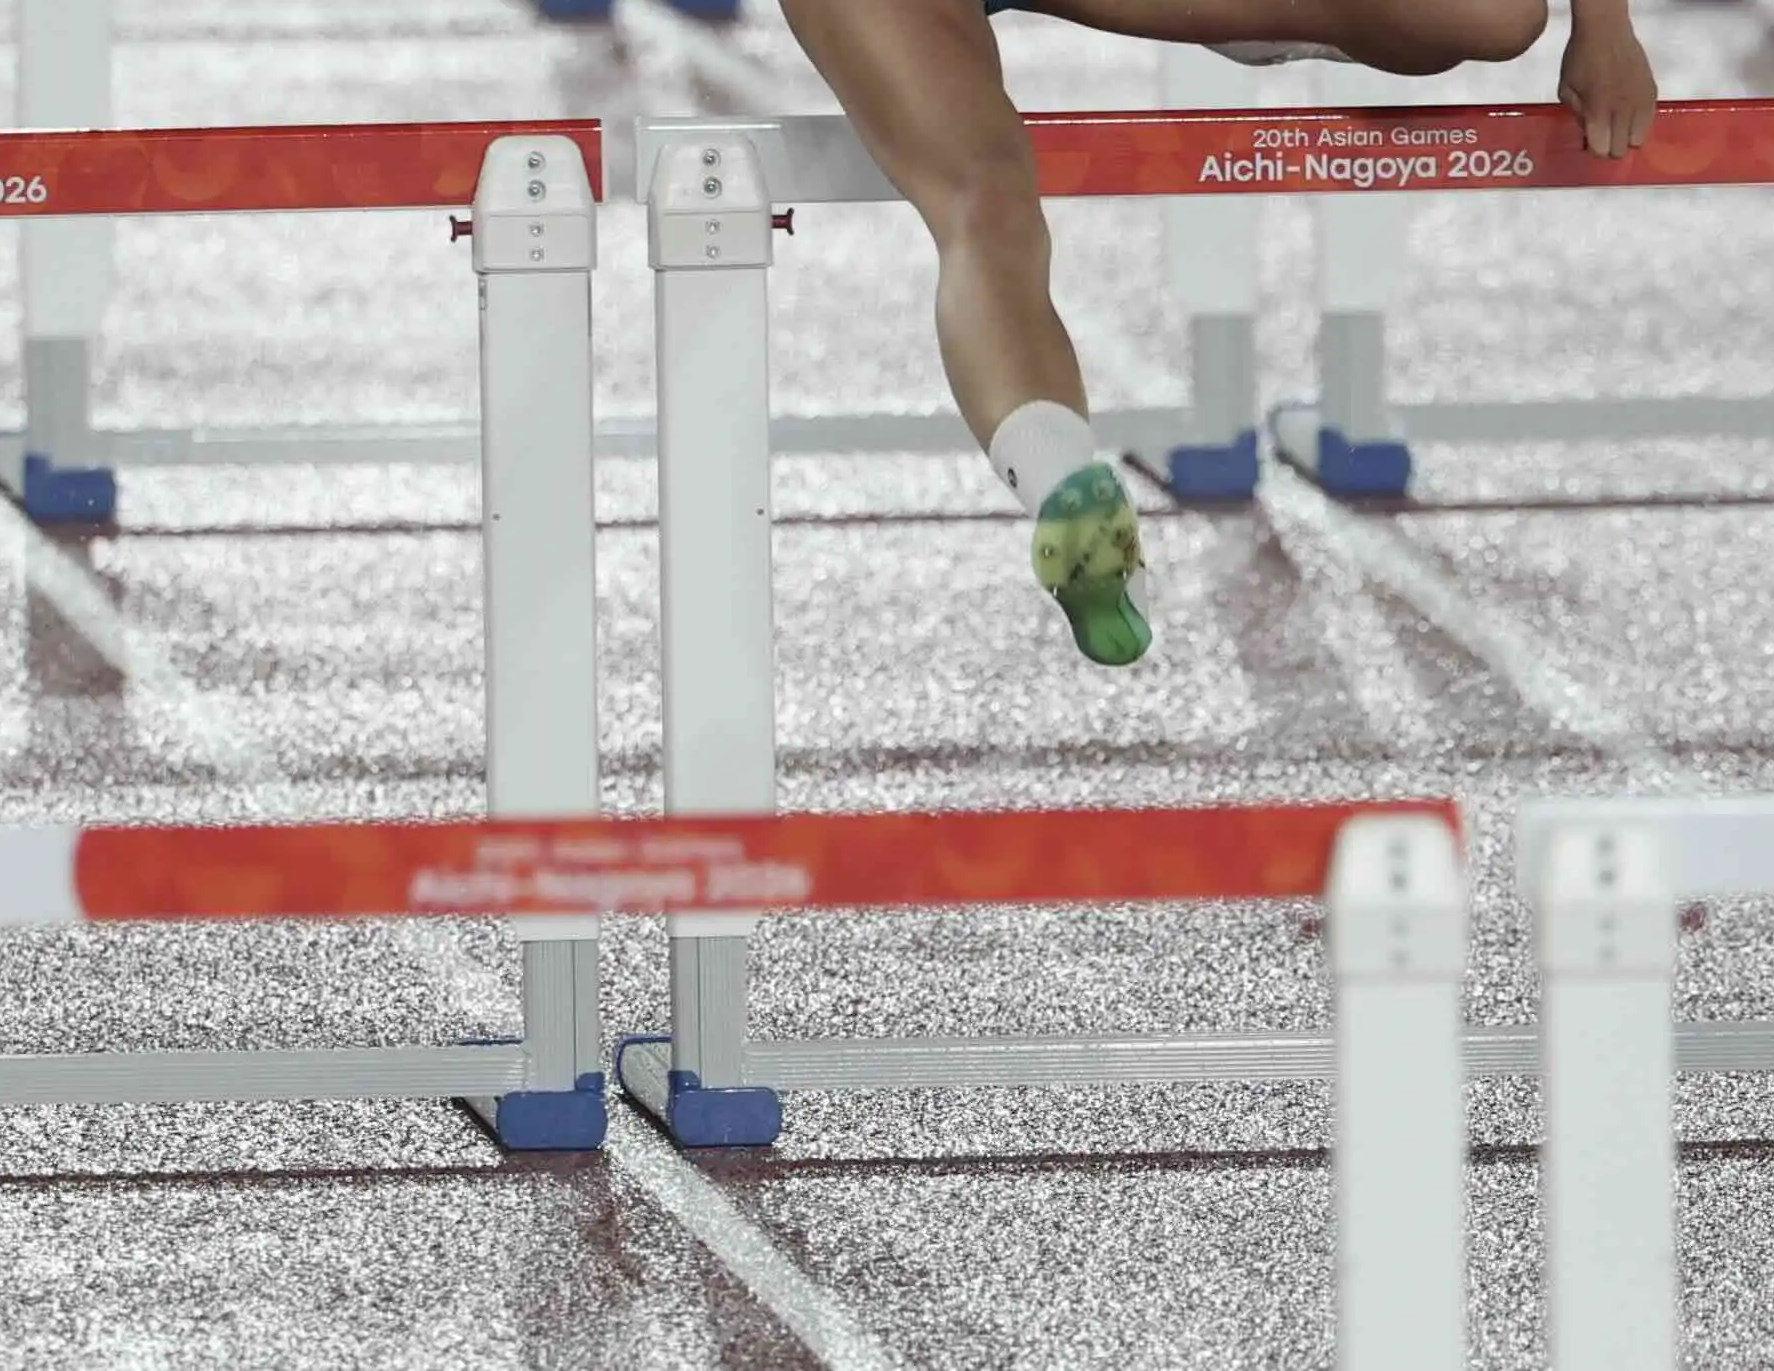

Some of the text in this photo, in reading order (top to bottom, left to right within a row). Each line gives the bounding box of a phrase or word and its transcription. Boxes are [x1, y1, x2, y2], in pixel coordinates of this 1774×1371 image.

[1252, 126, 1478, 148] 20th Asian Games
[1199, 150, 1534, 188] Aichi-Nagoya 2026
